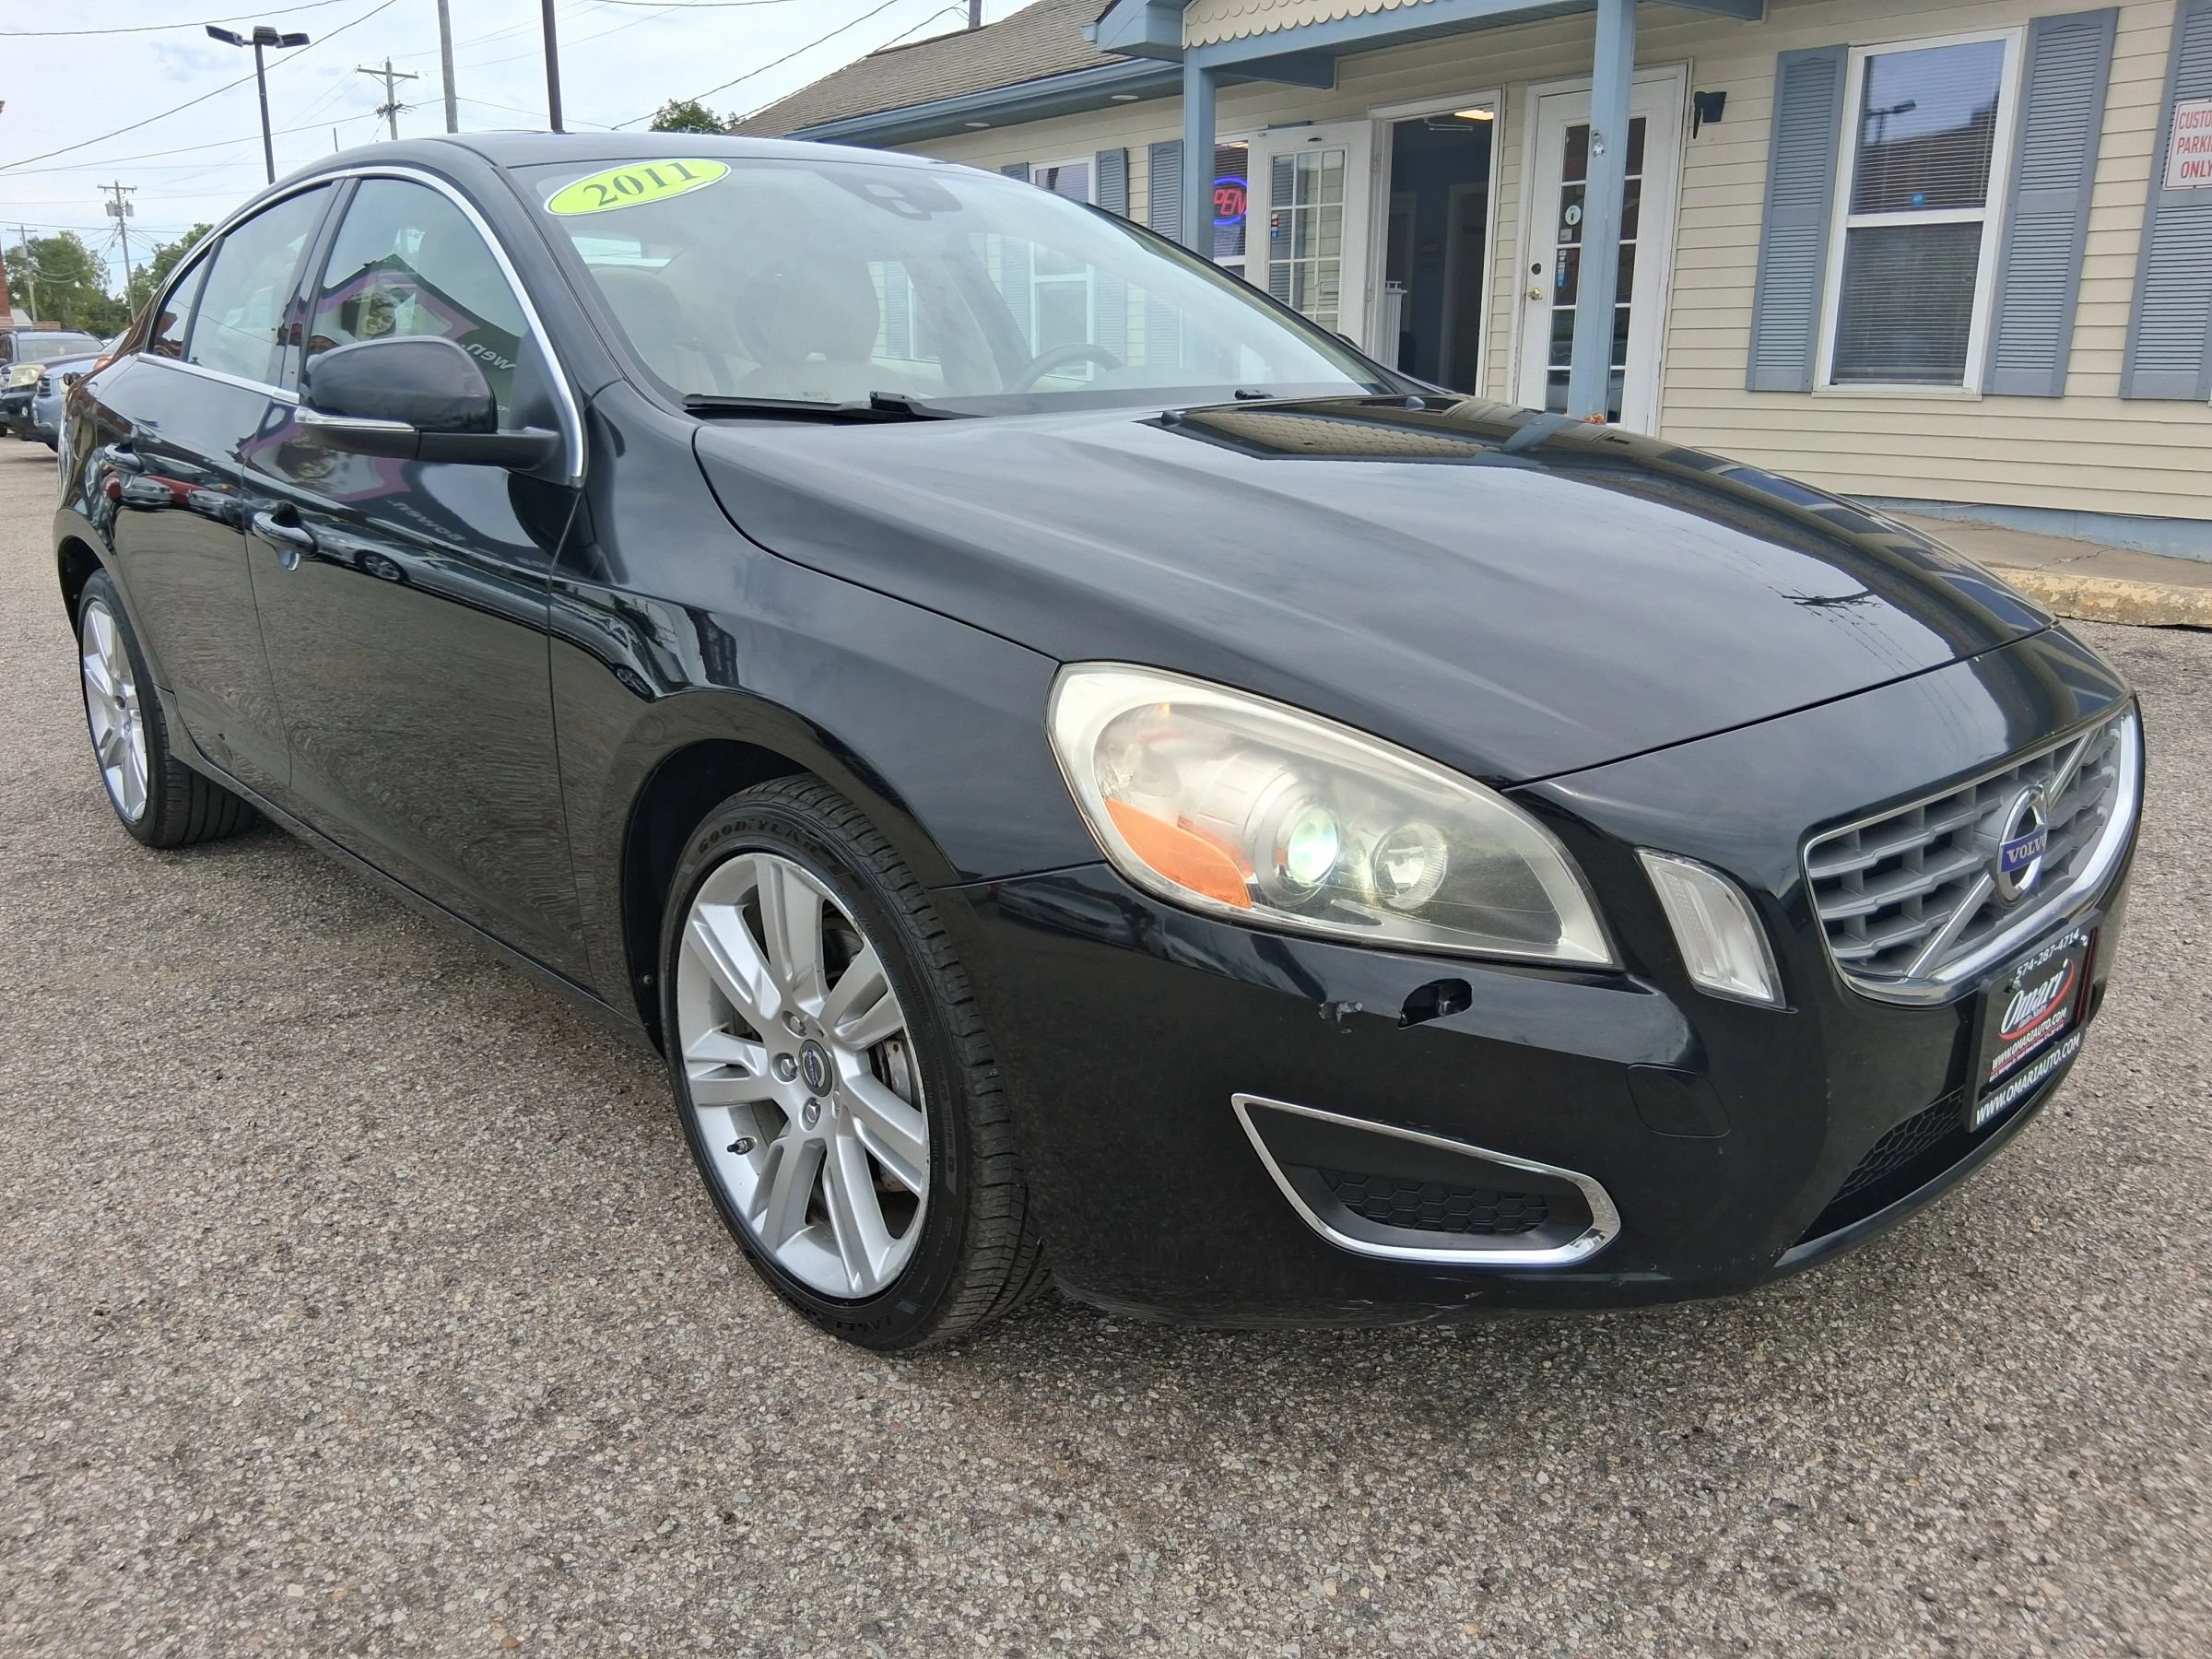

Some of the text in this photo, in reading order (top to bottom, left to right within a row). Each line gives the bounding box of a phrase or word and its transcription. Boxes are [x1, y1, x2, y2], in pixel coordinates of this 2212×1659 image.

[2179, 110, 2212, 129] CUSTO
[2176, 135, 2212, 155] PARKI
[582, 162, 700, 206] 2011
[1214, 188, 1247, 215] PEN
[2006, 832, 2047, 863] VOLVO
[2017, 928, 2079, 977] 574-287-4714
[2001, 958, 2068, 1033] Omari
[1993, 1007, 2067, 1071] WWW.OMARIAUTO.COM
[1976, 1032, 2080, 1125] WWW.OMARIAUTO.COM
